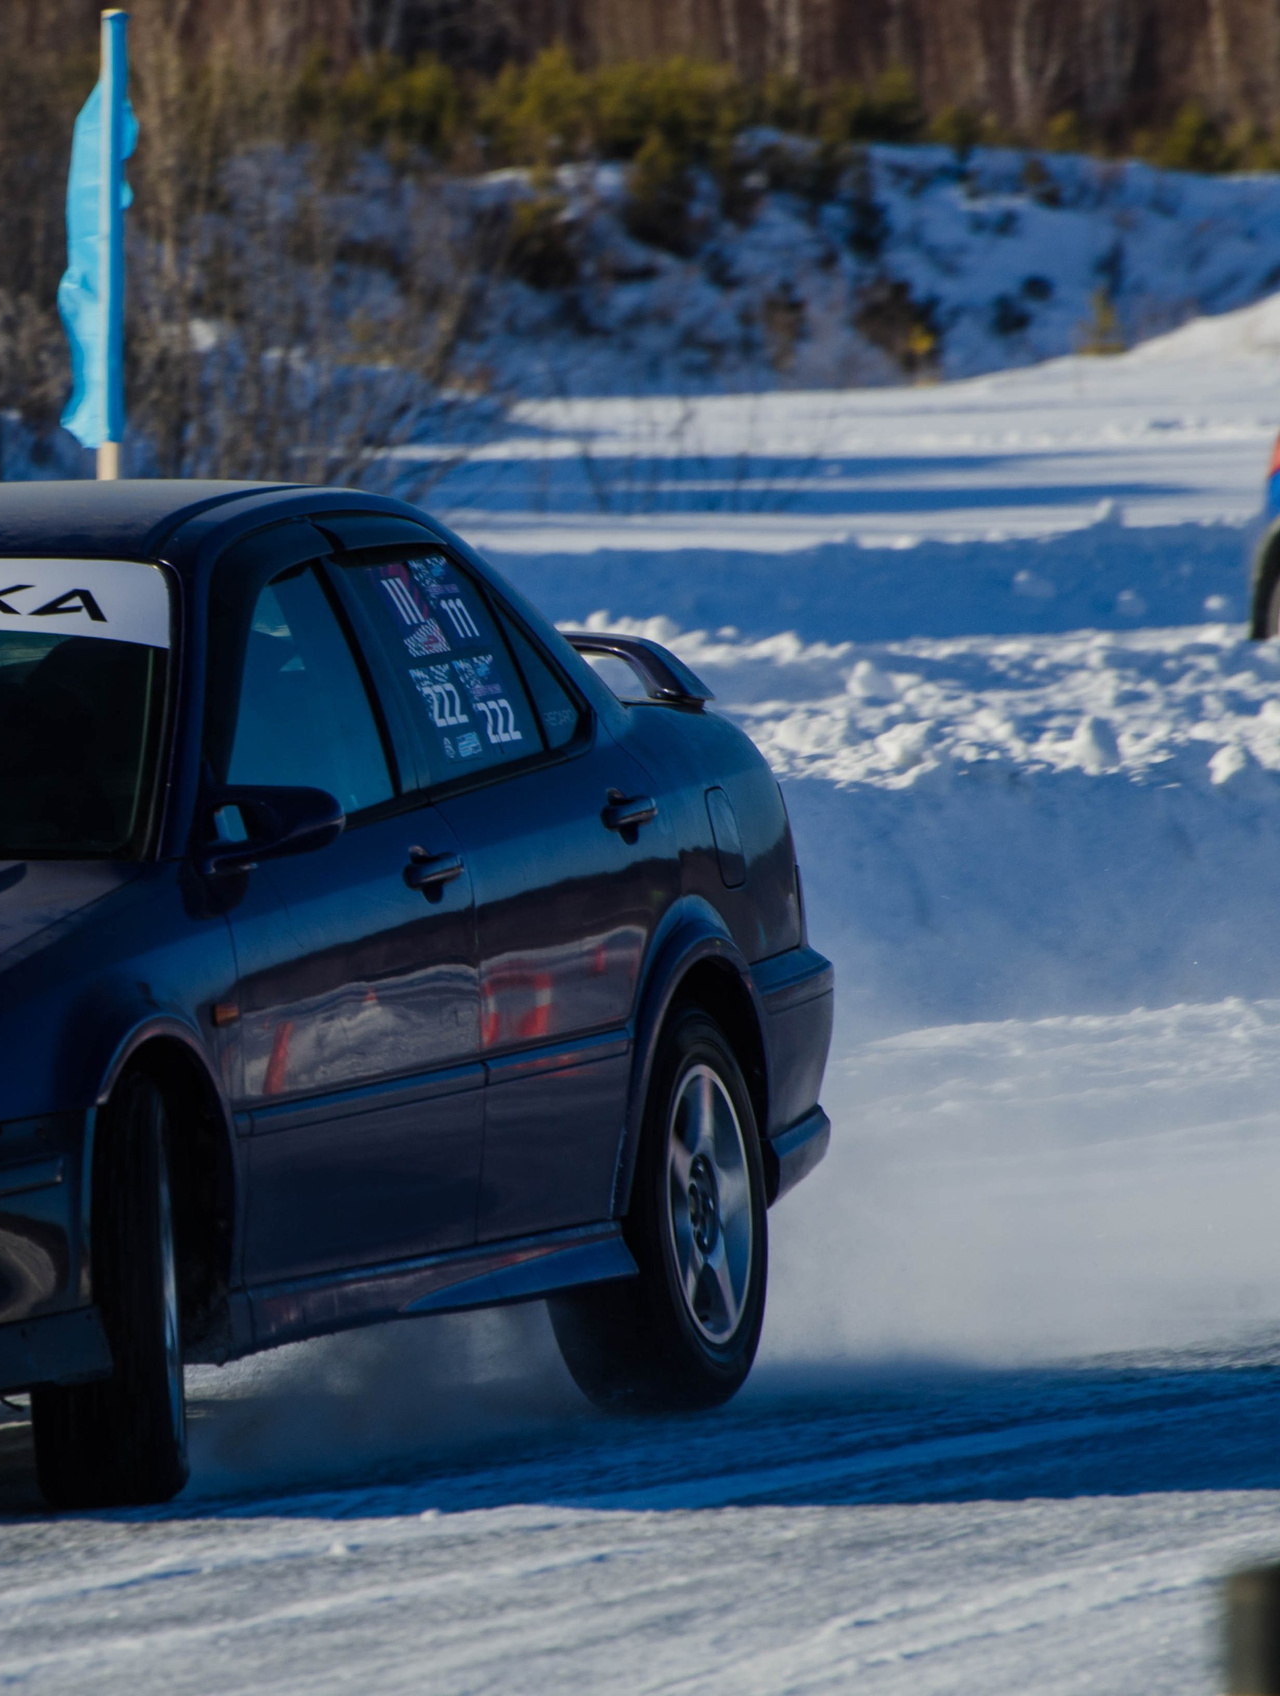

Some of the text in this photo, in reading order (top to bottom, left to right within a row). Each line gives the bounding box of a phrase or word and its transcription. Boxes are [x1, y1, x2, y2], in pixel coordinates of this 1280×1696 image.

[440, 599, 480, 638] 111
[421, 682, 469, 727] 222
[476, 698, 522, 744] 222
